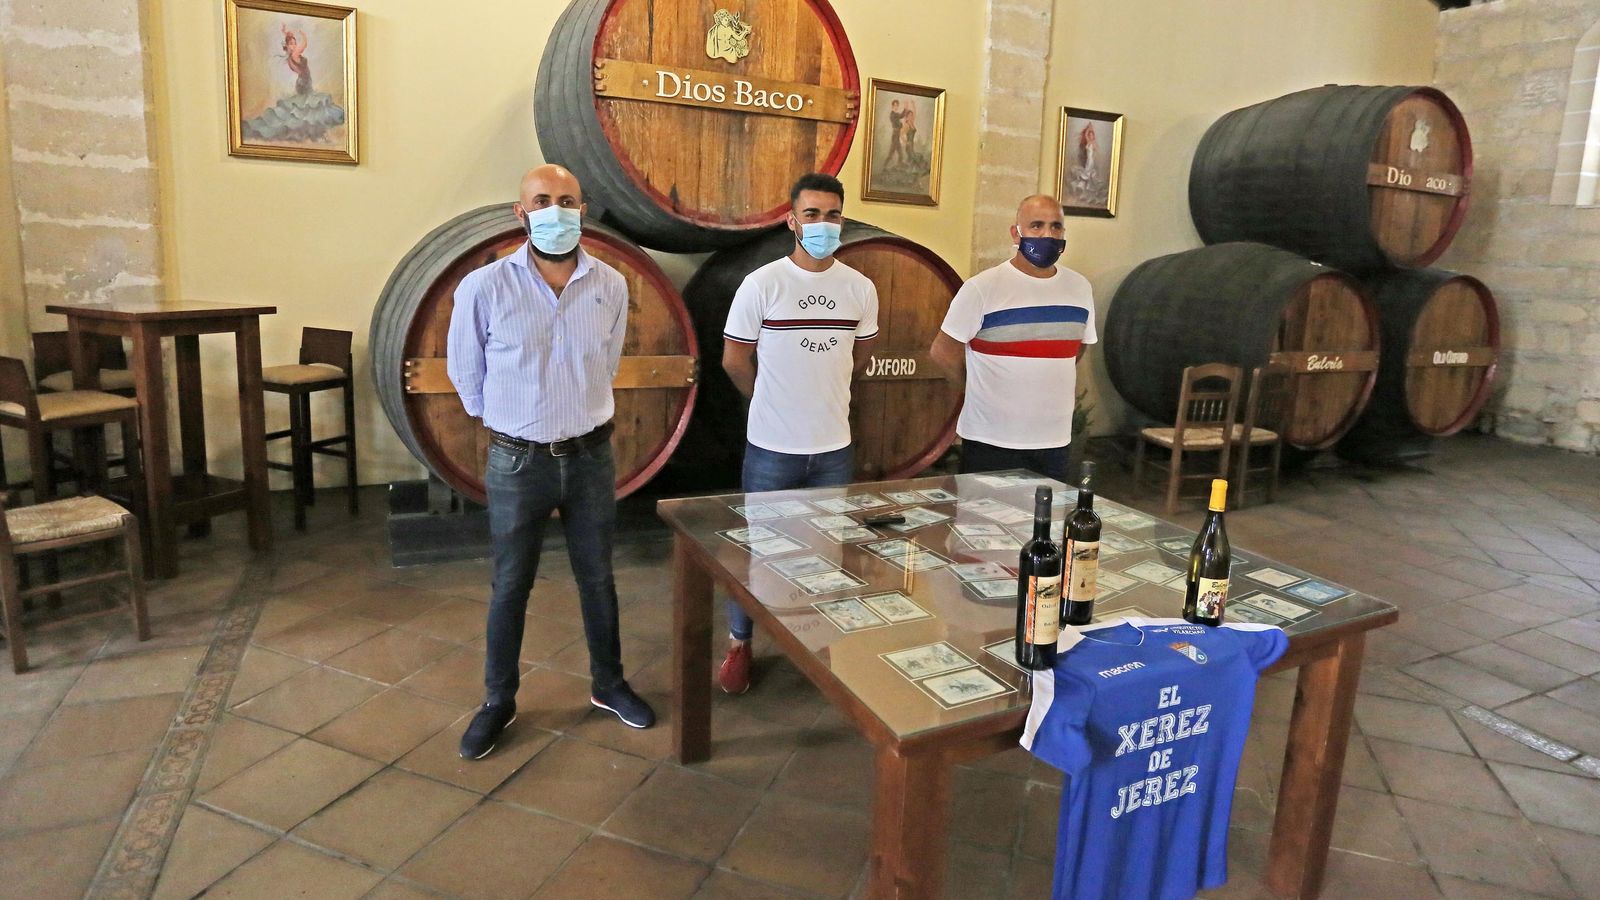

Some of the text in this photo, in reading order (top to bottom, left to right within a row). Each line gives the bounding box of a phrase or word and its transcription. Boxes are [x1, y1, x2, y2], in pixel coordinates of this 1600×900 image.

[655, 70, 804, 112] Dios Baco
[798, 294, 836, 310] GOOD
[800, 336, 838, 353] DEALS
[1098, 661, 1146, 679] macron
[1157, 684, 1181, 710] EL
[1114, 704, 1212, 757] XEREZ
[1147, 748, 1173, 773] DE
[1110, 764, 1199, 819] JEREZ
